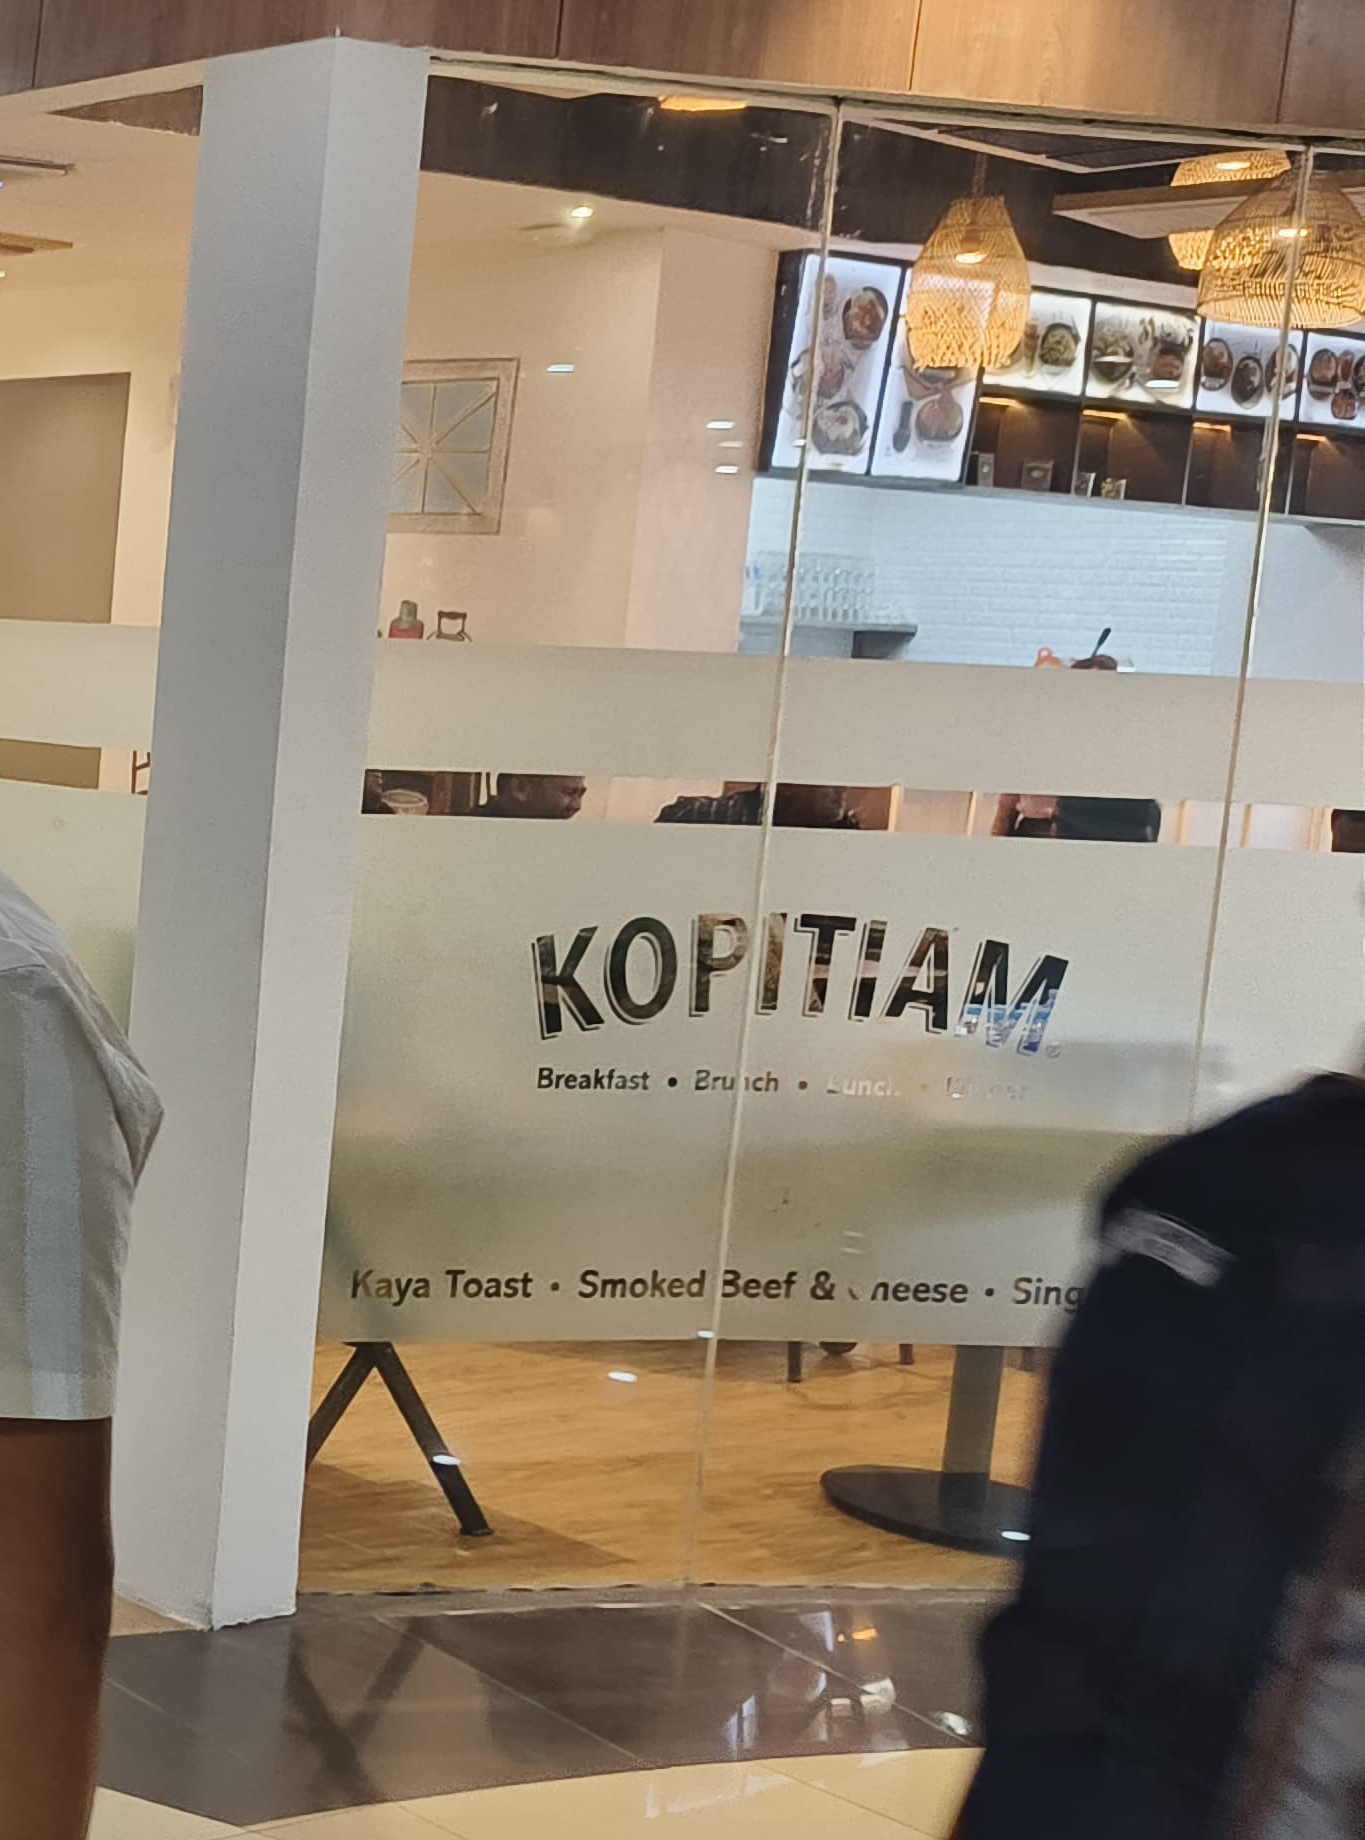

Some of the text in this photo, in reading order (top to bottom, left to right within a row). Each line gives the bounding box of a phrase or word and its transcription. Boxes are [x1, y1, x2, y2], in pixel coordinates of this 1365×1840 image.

[531, 911, 1070, 1056] KOPITIAM
[536, 1067, 651, 1091] Breakfast
[350, 1269, 431, 1307] Kaya
[444, 1268, 534, 1299] Toast
[577, 1269, 707, 1299] Smoked
[721, 1269, 798, 1299] Beef
[809, 1270, 836, 1301] &
